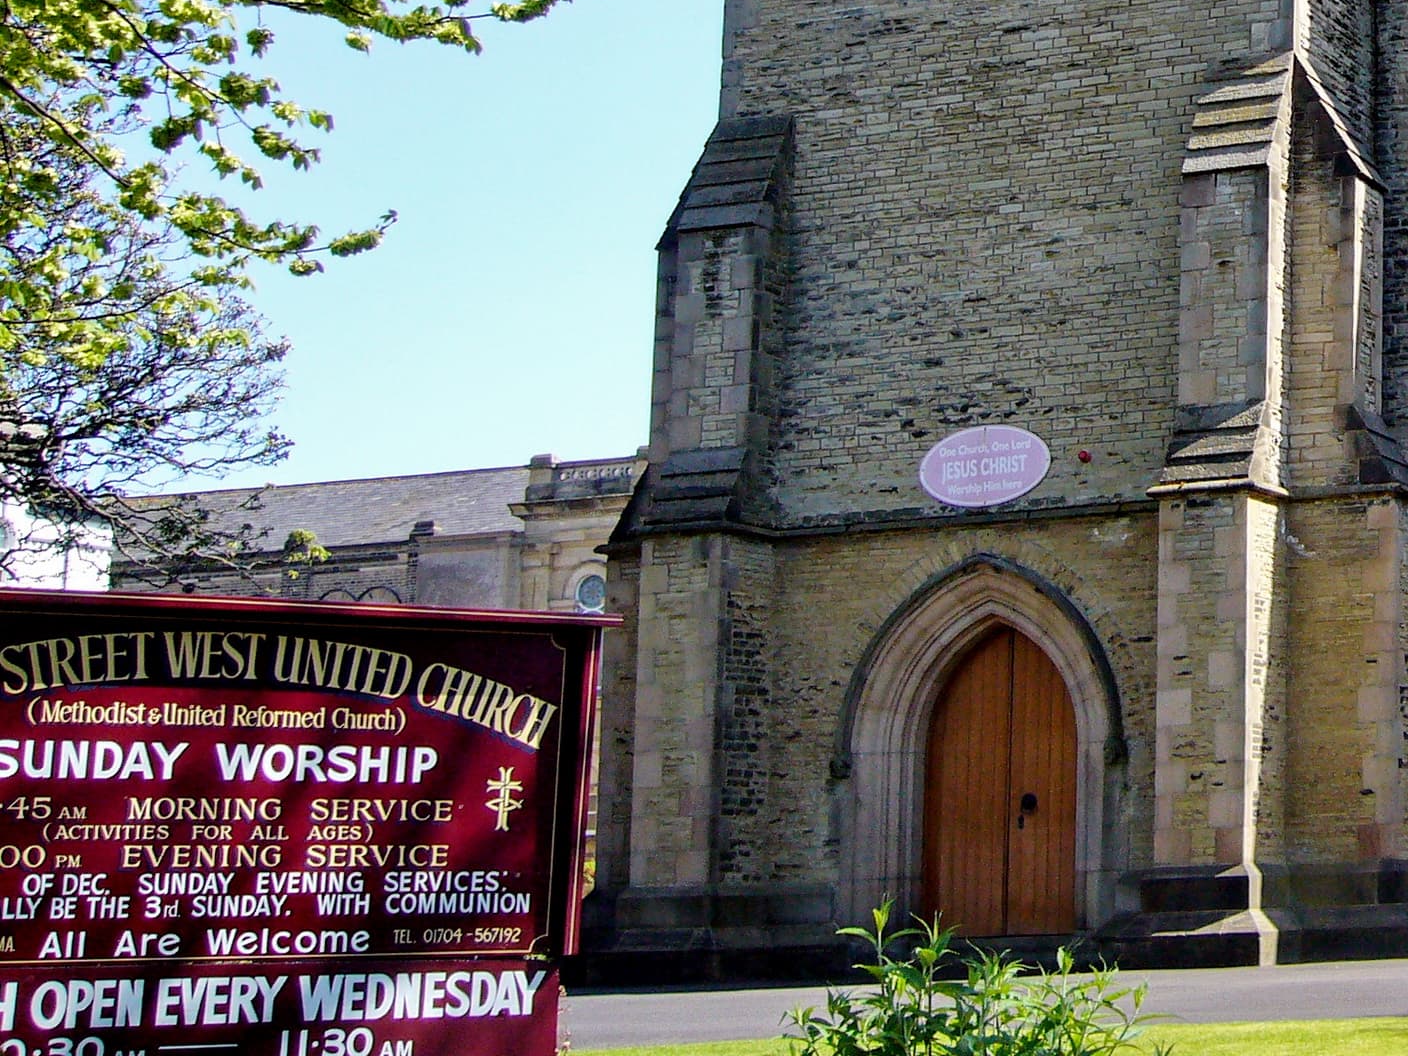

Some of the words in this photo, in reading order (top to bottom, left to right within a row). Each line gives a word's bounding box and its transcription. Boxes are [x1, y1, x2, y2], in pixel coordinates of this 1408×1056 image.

[992, 441, 1009, 451] One
[1012, 439, 1032, 449] Lord
[942, 459, 977, 484] JESUS
[981, 455, 1028, 475] CHRIST
[949, 483, 982, 495] Worship
[0, 632, 154, 694] STREET
[162, 632, 266, 680] WEST
[273, 635, 413, 700] UNITED
[417, 663, 558, 750] CHURCH
[231, 705, 326, 730] Reformed
[331, 707, 406, 735] Church)
[0, 739, 189, 780] SUNDAY
[215, 742, 438, 784] WORSHIP
[57, 806, 88, 820] AM
[126, 797, 282, 821] MORNING
[310, 798, 454, 821] SERVICE
[191, 825, 233, 840] FOR
[250, 825, 289, 840] ALL
[306, 823, 374, 842] AGES)
[122, 845, 282, 868] EVENING
[306, 844, 450, 867] SERVICE
[23, 873, 54, 896] OF
[62, 873, 110, 896] DEC.
[138, 872, 235, 895] SUNDAY
[256, 871, 364, 894] EVENING
[50, 897, 78, 920] BE
[87, 896, 131, 919] THE
[192, 894, 292, 918] SUNDAY.
[317, 893, 370, 916] WITH
[385, 893, 531, 915] COMMUNION
[38, 930, 87, 960] All
[113, 928, 181, 958] Are
[207, 927, 371, 957] Welcome
[393, 928, 417, 944] TEL.
[30, 978, 145, 1031] OPEN
[154, 975, 289, 1027] EVERY
[299, 970, 548, 1022] WEDNESDAY
[380, 1040, 414, 1056] AM
